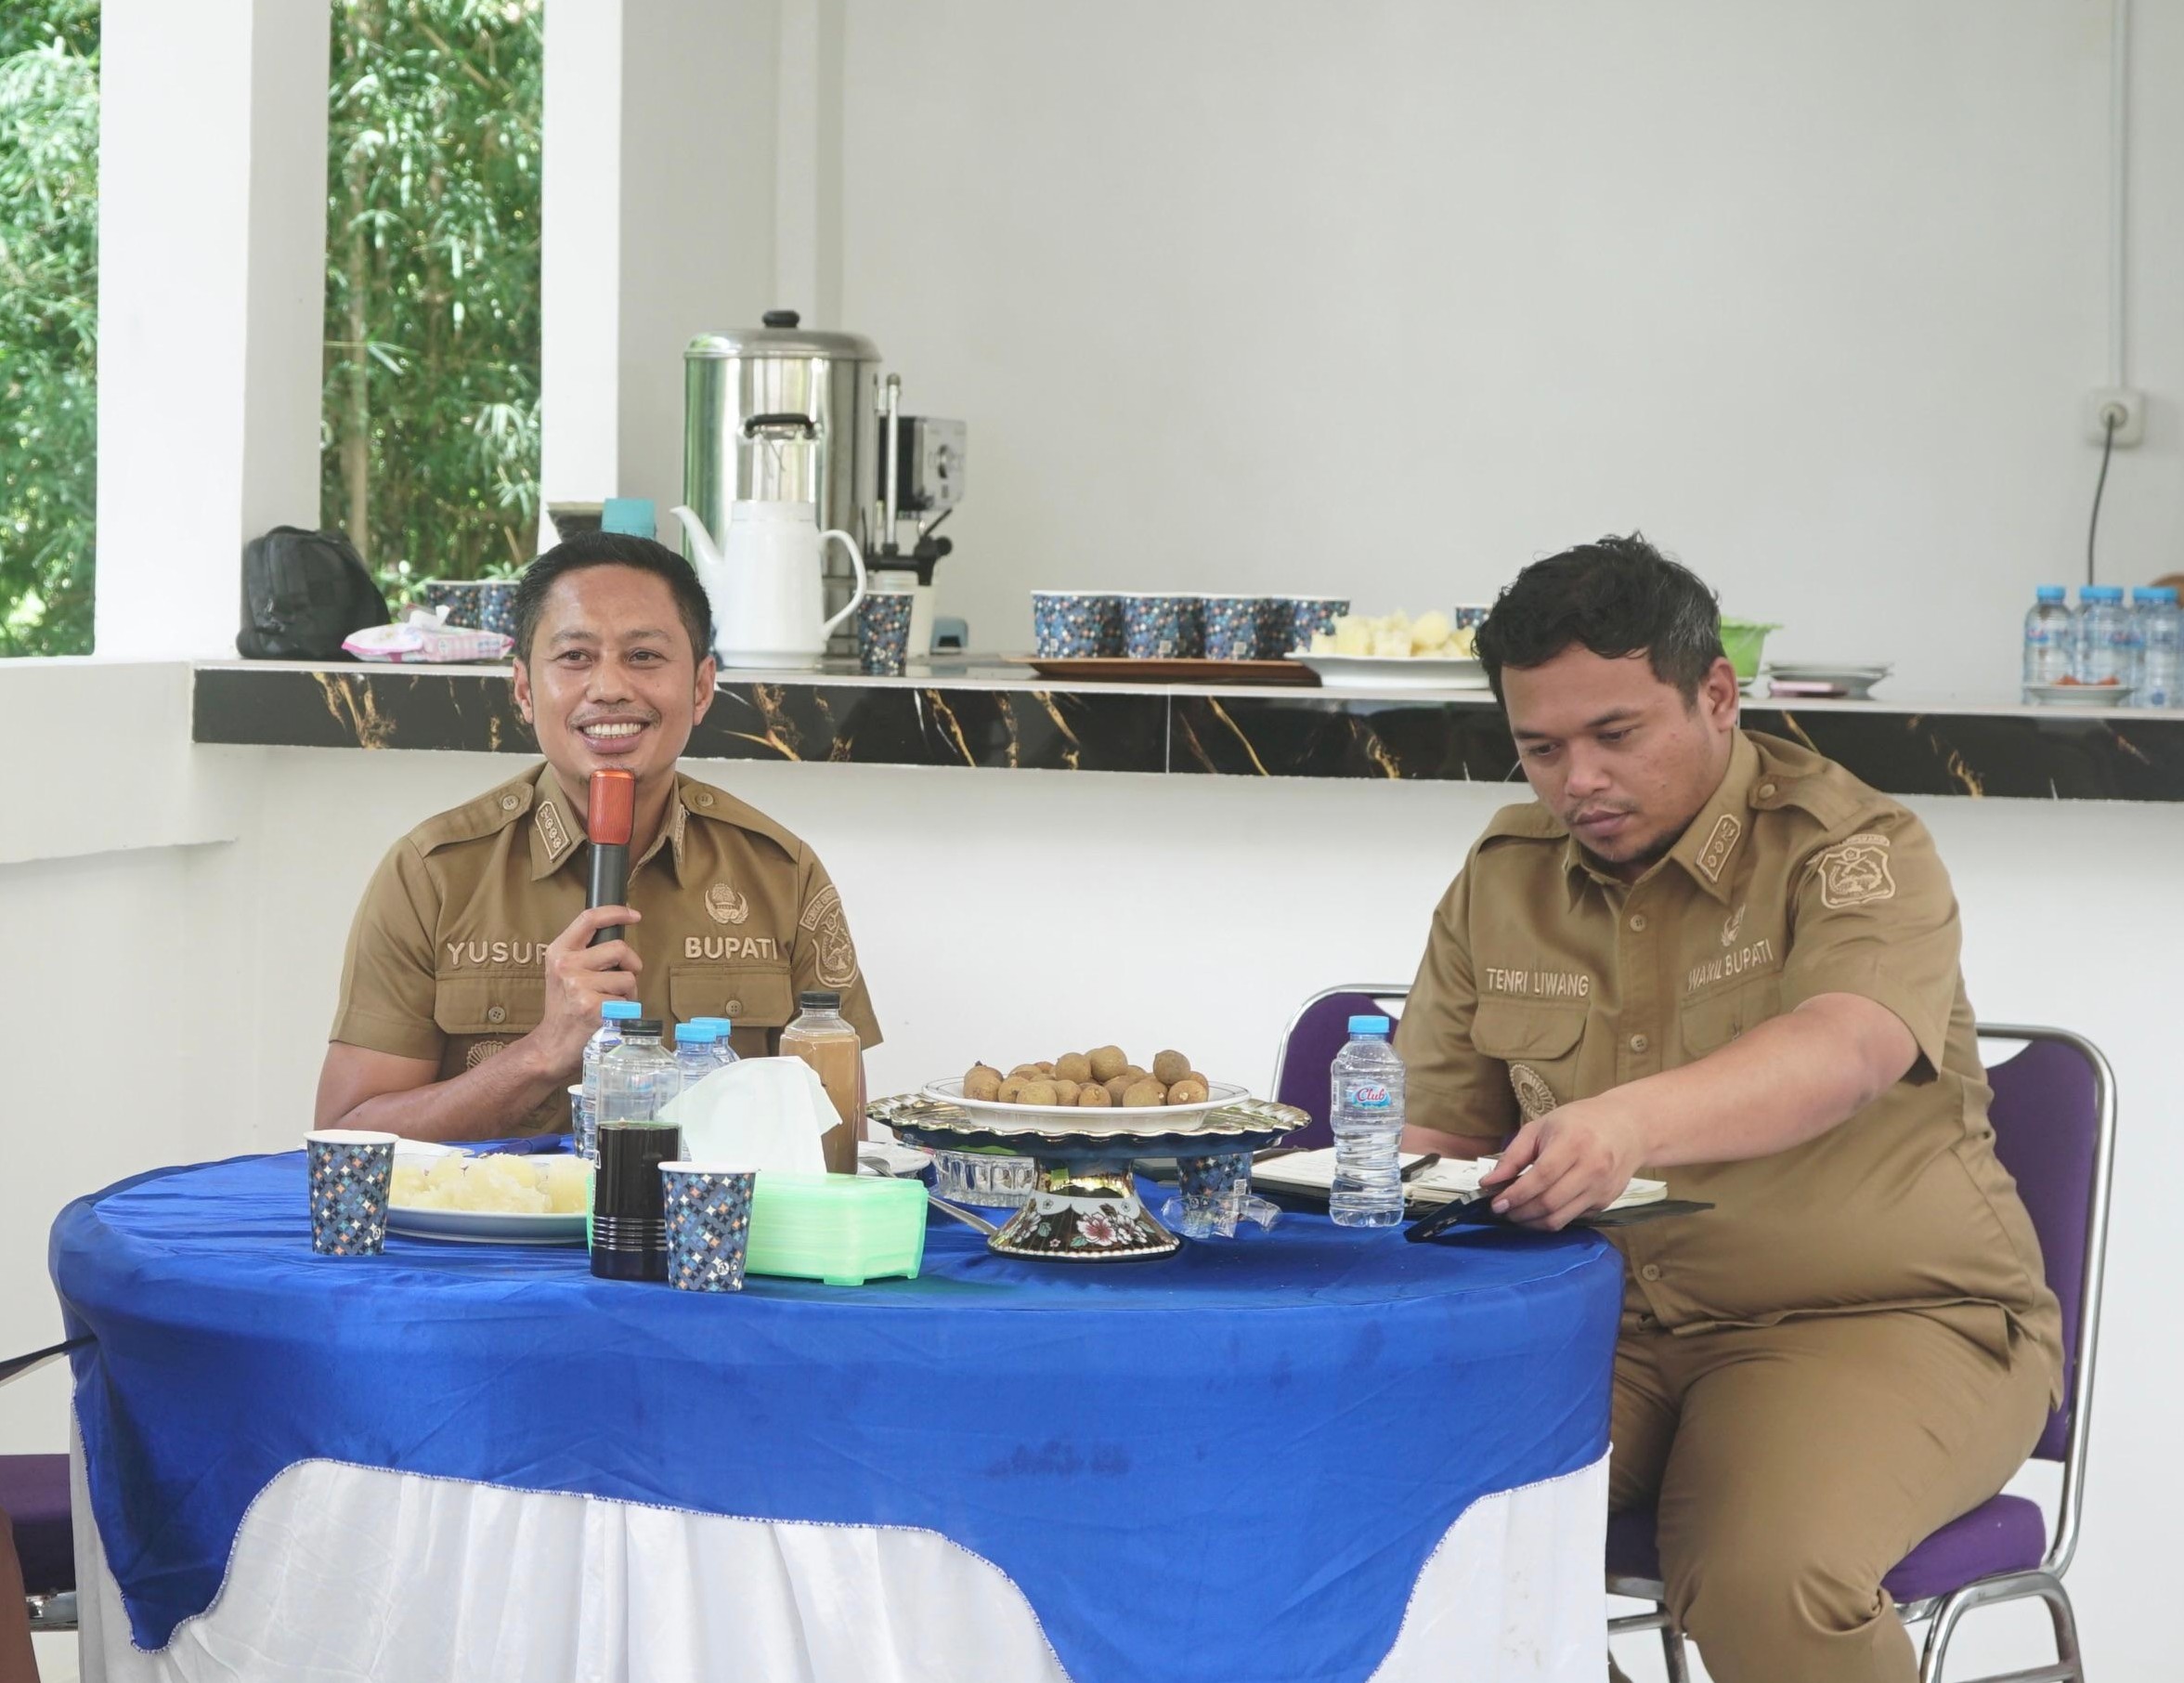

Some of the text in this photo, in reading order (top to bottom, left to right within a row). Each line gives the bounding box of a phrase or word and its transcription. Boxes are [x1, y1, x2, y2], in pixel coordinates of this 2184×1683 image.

[684, 936, 778, 960] BUPATI
[1688, 938, 1774, 992] WAKIL BUPATI
[1486, 968, 1589, 998] TENRI LIWANG
[1357, 1088, 1385, 1102] Club
